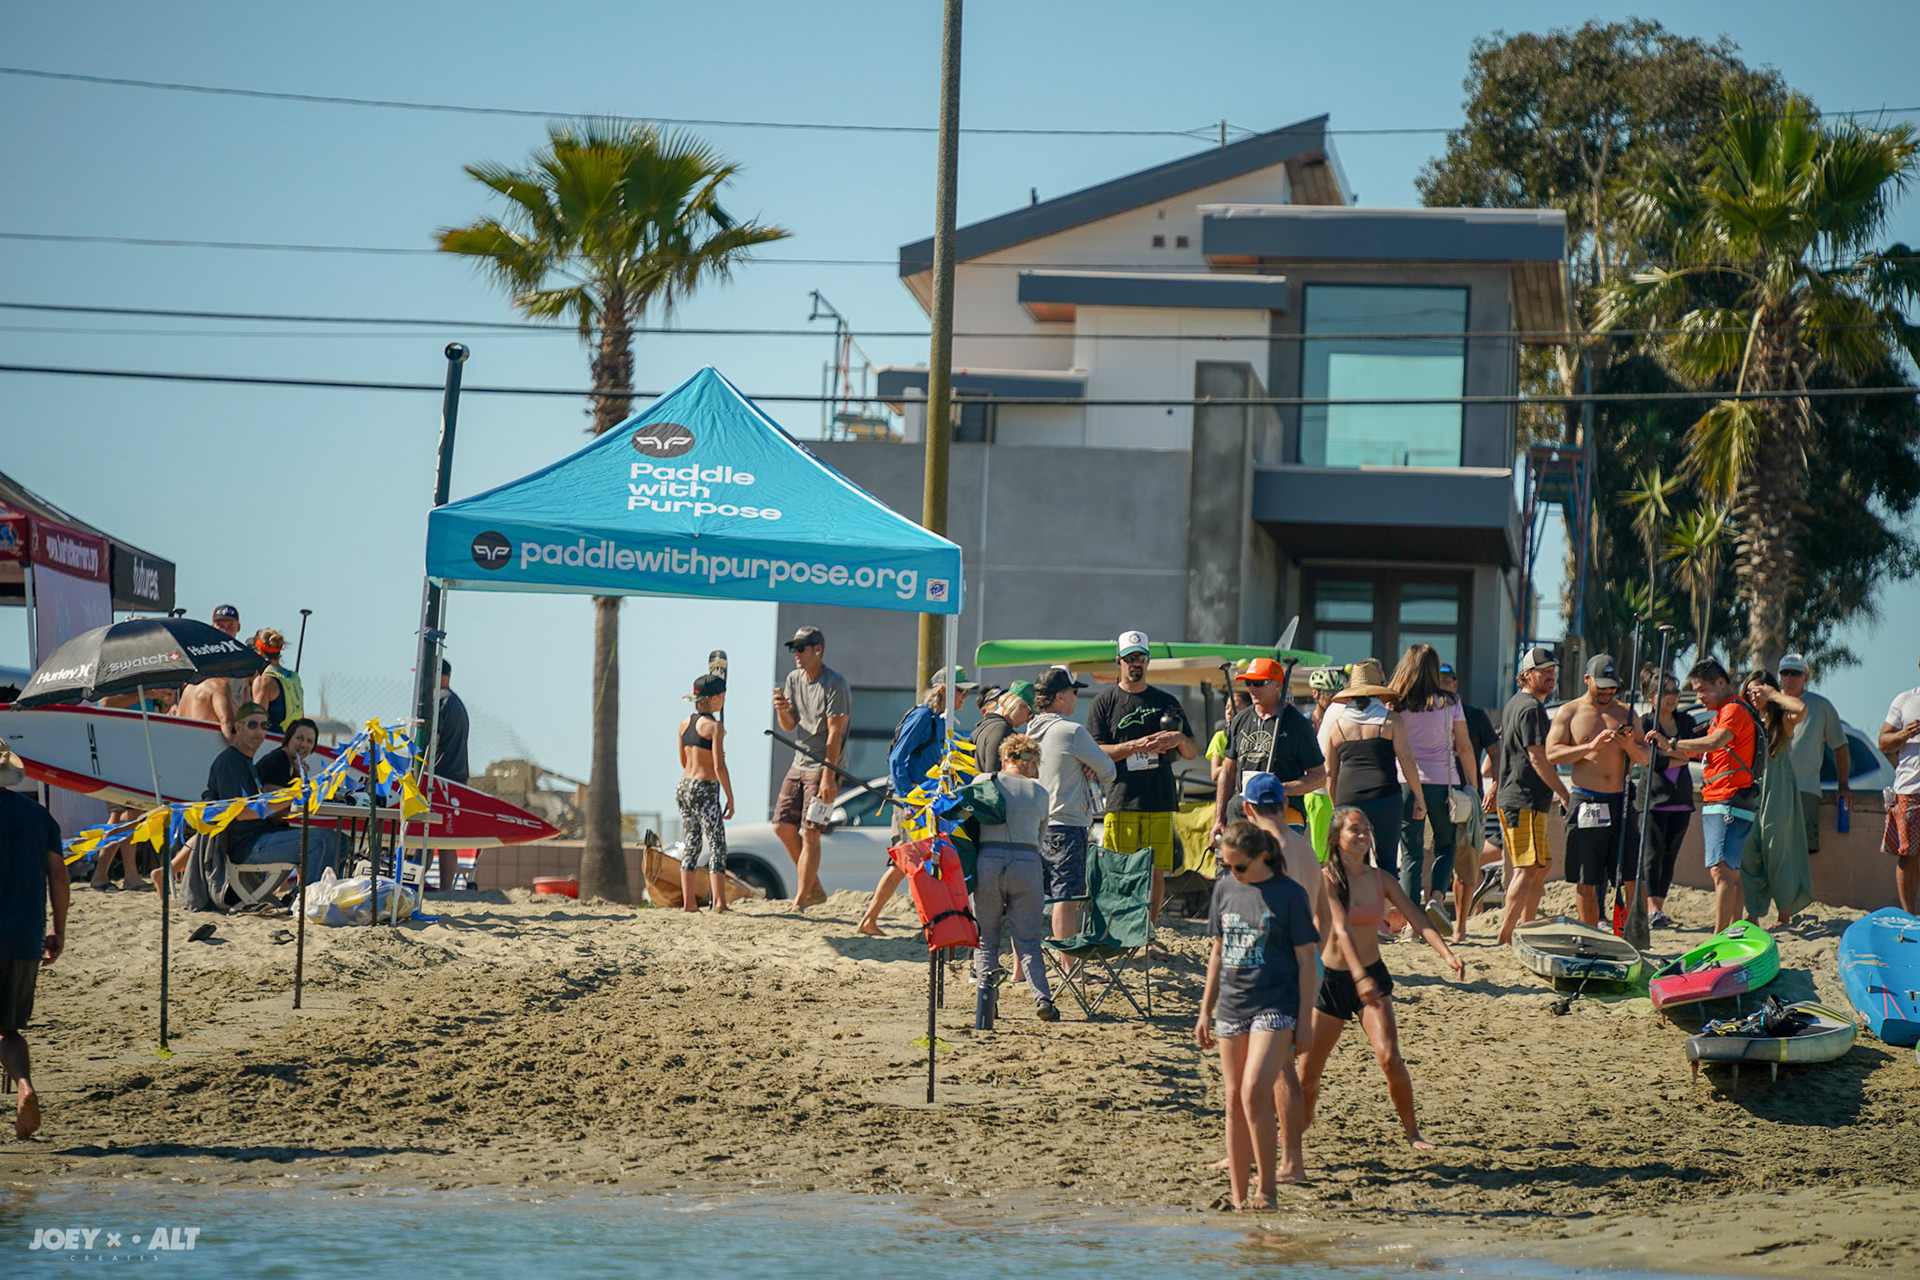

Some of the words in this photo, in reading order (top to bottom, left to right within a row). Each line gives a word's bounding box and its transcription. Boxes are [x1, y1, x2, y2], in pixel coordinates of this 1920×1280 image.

[630, 462, 755, 485] Paddle
[627, 480, 710, 498] with
[627, 496, 782, 520] Purpose
[520, 538, 918, 600] paddlewithpurpose.org
[187, 641, 227, 657] Hurley
[109, 653, 168, 672] swatch
[36, 667, 78, 685] Hurley
